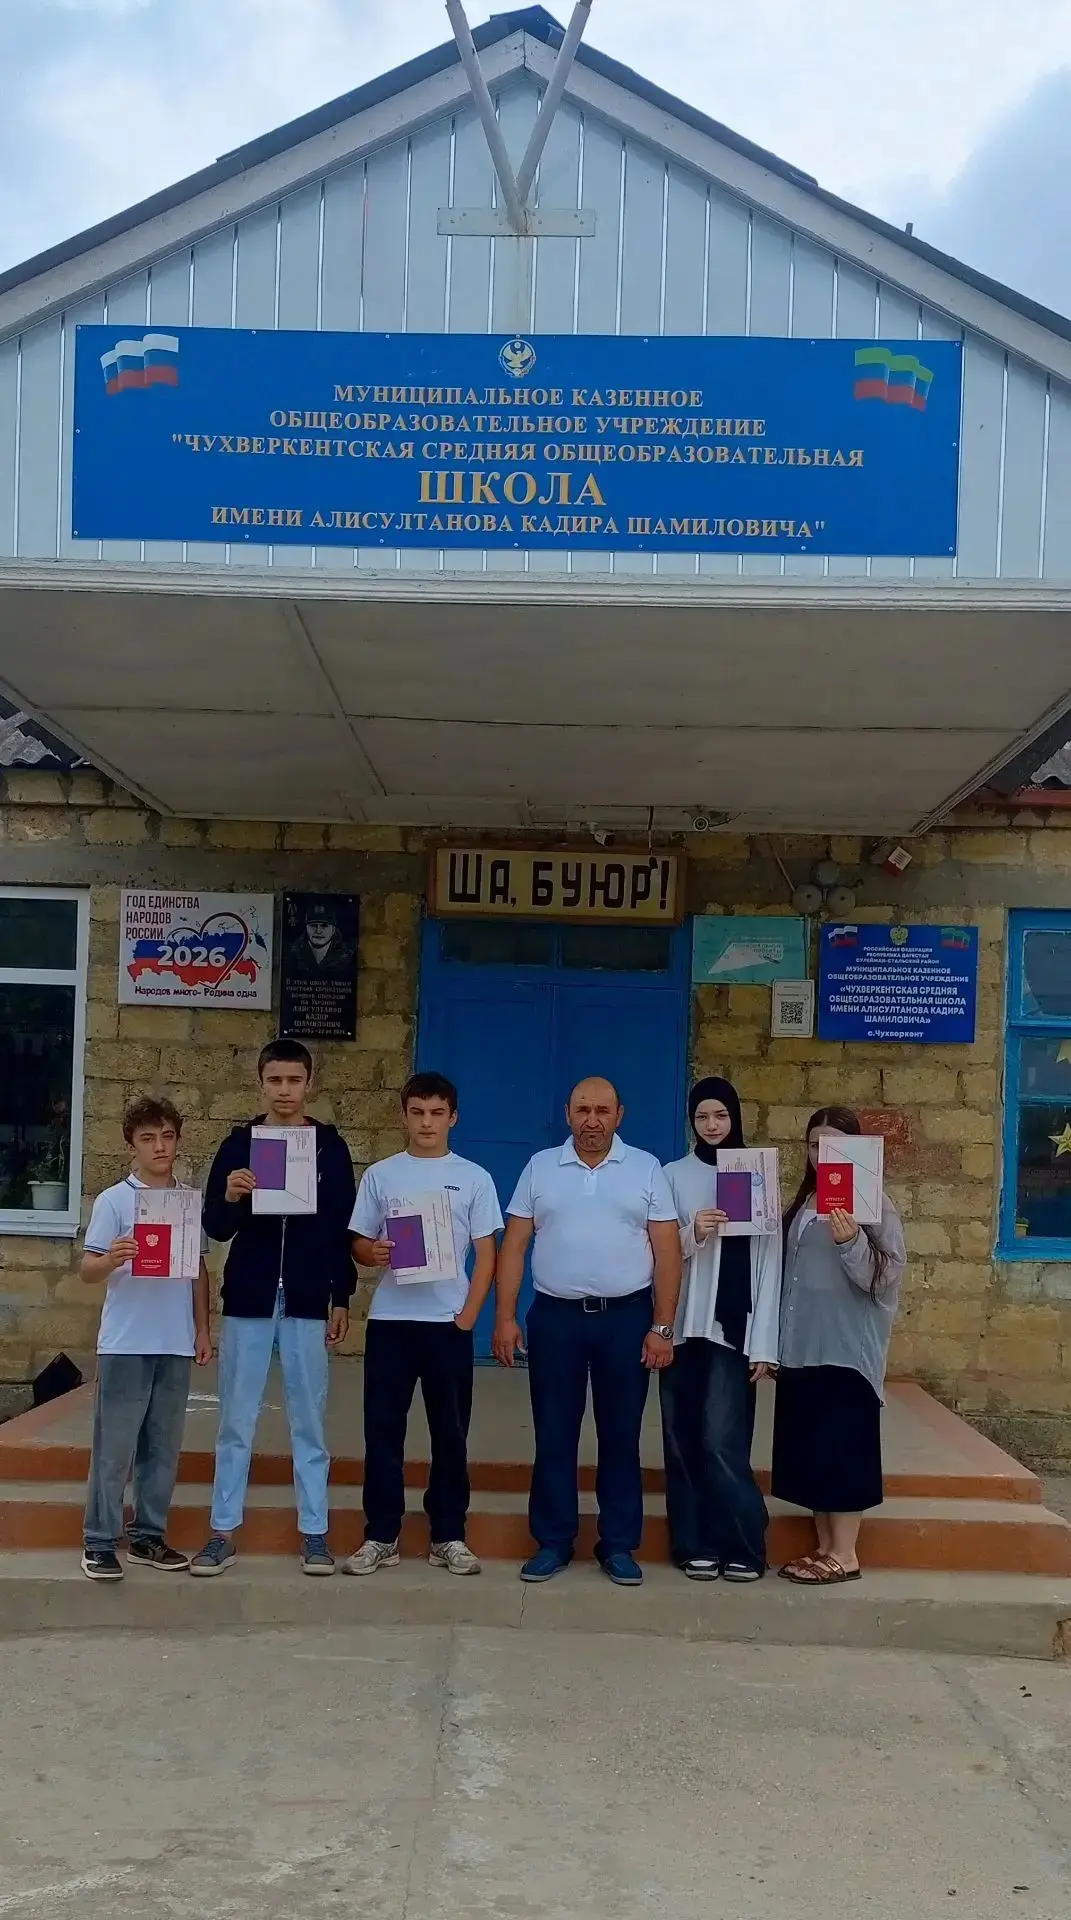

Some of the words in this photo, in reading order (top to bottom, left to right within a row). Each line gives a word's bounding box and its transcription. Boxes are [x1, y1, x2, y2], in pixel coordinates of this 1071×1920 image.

[333, 385, 564, 407] МУНИЦИПАЛЬНОЕ
[571, 389, 704, 407] КАЗЕННОЕ
[270, 410, 588, 433] ОБЩЕОБРАЗОВАТЕЛЬНОЕ
[595, 417, 766, 438] УЧРЕЖДЕНИЕ
[171, 433, 415, 459] "ЧУХВЕРКЕНТСКАЯ
[421, 442, 536, 463] СРЕДНЯЯ
[543, 444, 864, 467] ОБЩЕОБРАЗОВАТЕЛЬНАЯ
[417, 470, 607, 505] ШКОЛА
[210, 506, 303, 527] ИМЕНИ
[309, 511, 514, 532] АЛИСУЛТАНОВА
[520, 515, 619, 536] КАДИРА
[627, 517, 825, 538] ШАМИЛОВИЧА"
[448, 853, 517, 907] ША,
[531, 859, 670, 910] БУЮР!
[126, 895, 146, 909] ГОД
[148, 896, 200, 909] ЕДИНСТВА
[126, 911, 171, 925] НАРОДОВ
[125, 927, 166, 940] РОССИИ.
[157, 945, 226, 967] 2026
[845, 966, 912, 974] МУНИЦИПАЛЬНОЕ
[827, 973, 919, 981] ОБЩЕОБРАЗОВАТЕЛЬНОЕ
[920, 975, 969, 983] УЧРЕЖДЕНИЕ
[135, 986, 170, 997] Народов
[204, 988, 234, 998] Родина
[236, 990, 257, 998] одна
[840, 985, 918, 995] «ЧУХВЕРКЕНТСКАЯ
[919, 987, 958, 996] СРЕДНЯЯ
[829, 994, 933, 1004] ОБЩЕОБРАЗОВАТЕЛЬНАЯ
[935, 997, 967, 1005] ШКОЛА
[830, 1005, 859, 1013] ИМЕНИ
[861, 1006, 929, 1015] АЛИСУЛТАНОВА
[930, 1007, 965, 1016] КАДИРА
[864, 1015, 931, 1024] ШАМИЛОВИЧА»
